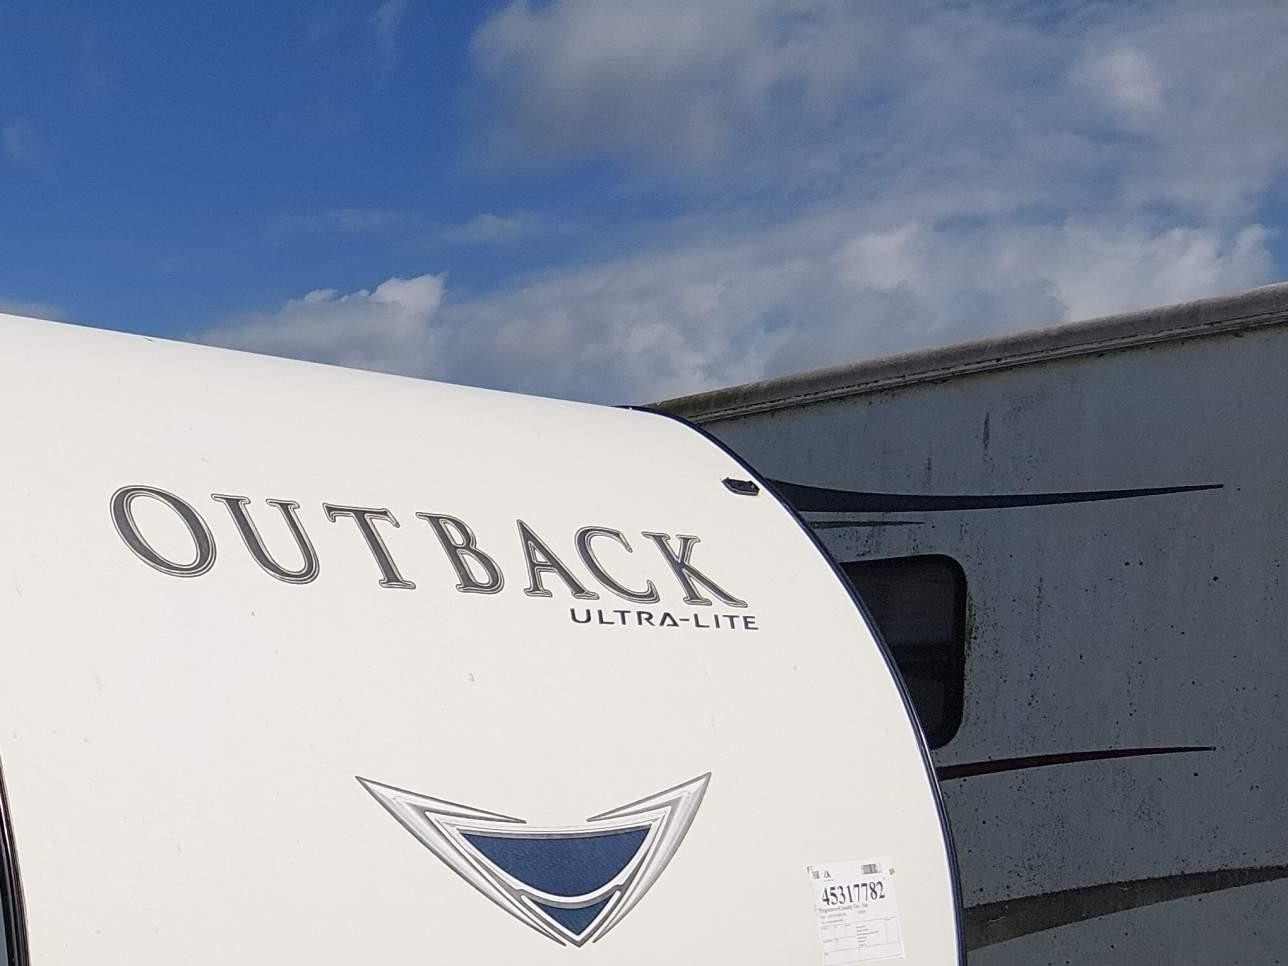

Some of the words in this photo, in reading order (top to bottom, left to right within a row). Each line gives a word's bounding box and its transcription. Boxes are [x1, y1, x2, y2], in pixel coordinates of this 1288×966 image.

[110, 485, 748, 608] OUTBACK
[570, 608, 759, 630] ULTRA-LITE
[822, 881, 885, 905] 45317782
